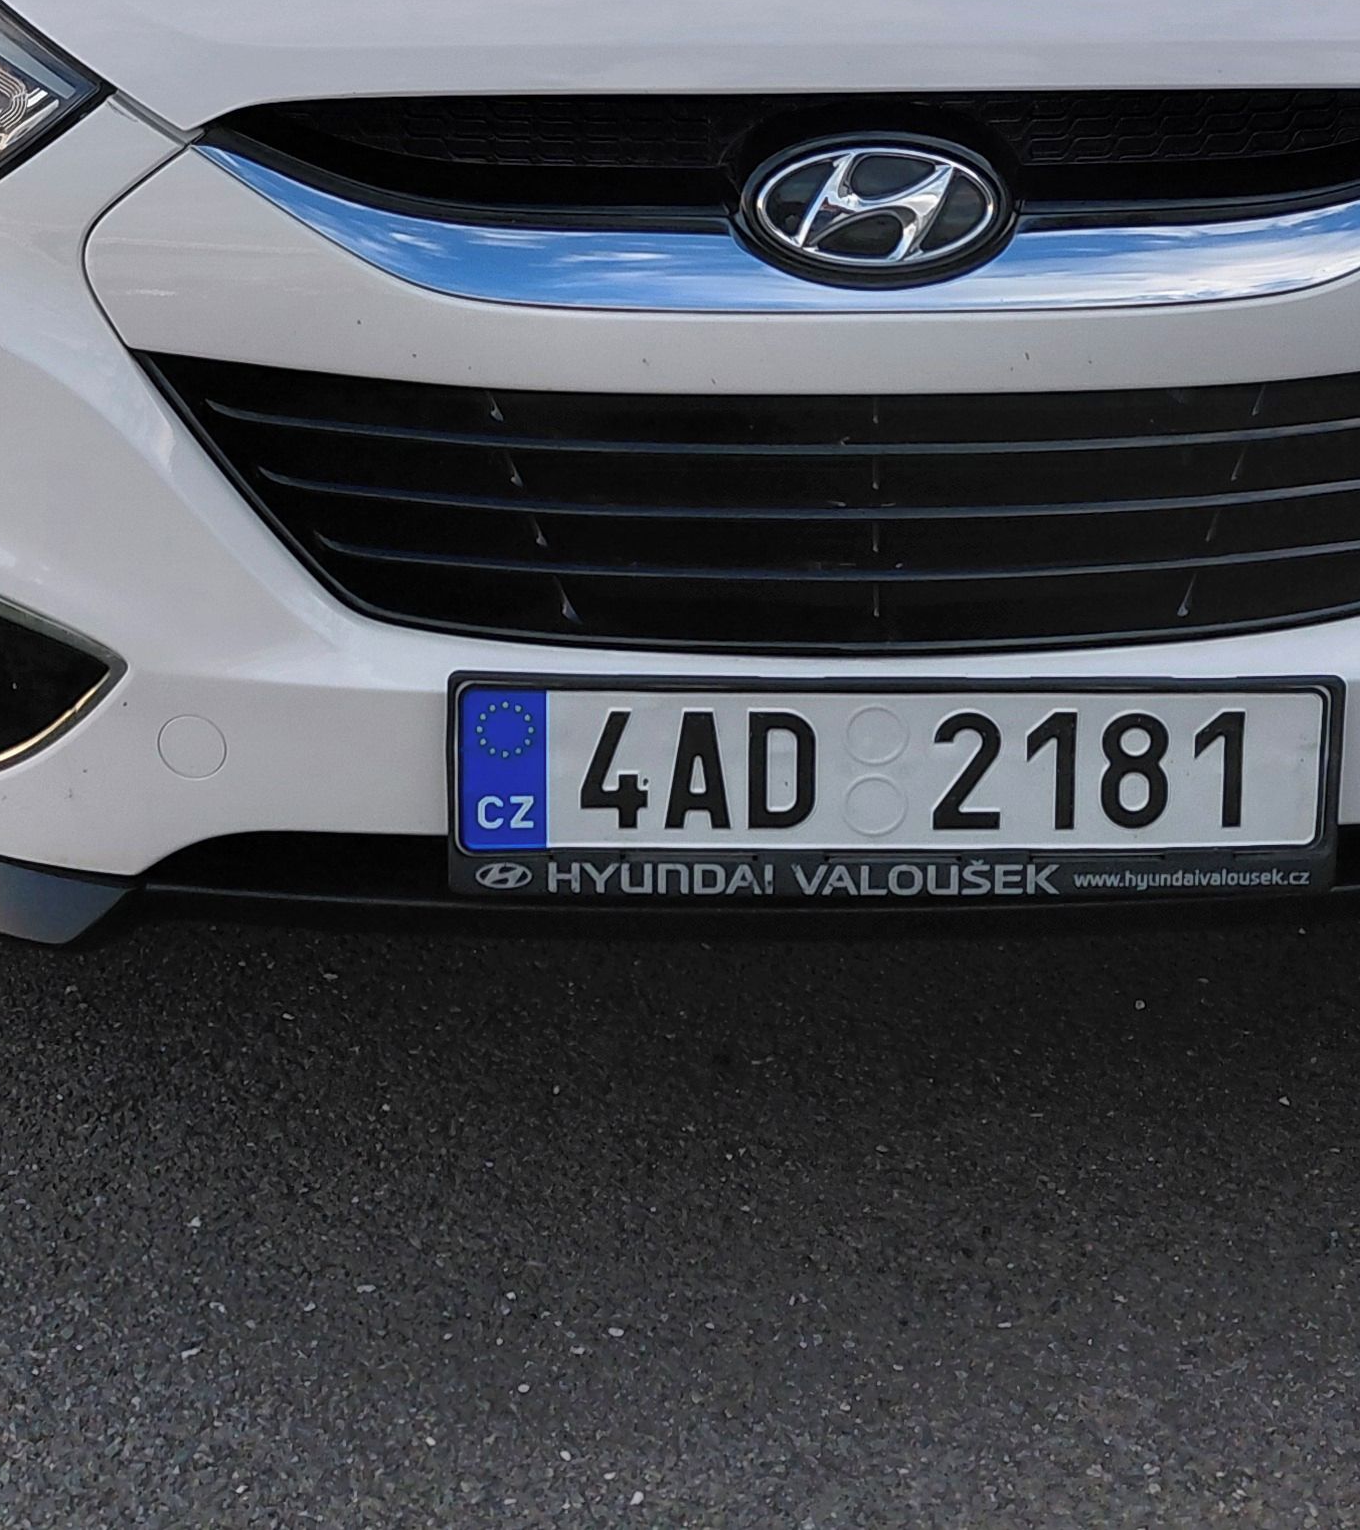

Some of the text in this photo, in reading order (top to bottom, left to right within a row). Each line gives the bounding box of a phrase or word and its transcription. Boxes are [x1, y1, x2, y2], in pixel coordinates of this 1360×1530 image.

[580, 709, 1246, 831] 4AD 2181
[477, 795, 534, 830] CZ
[547, 860, 1310, 896] HYUNDAI VALOUŠEK www.hyundaivalousek.cz
